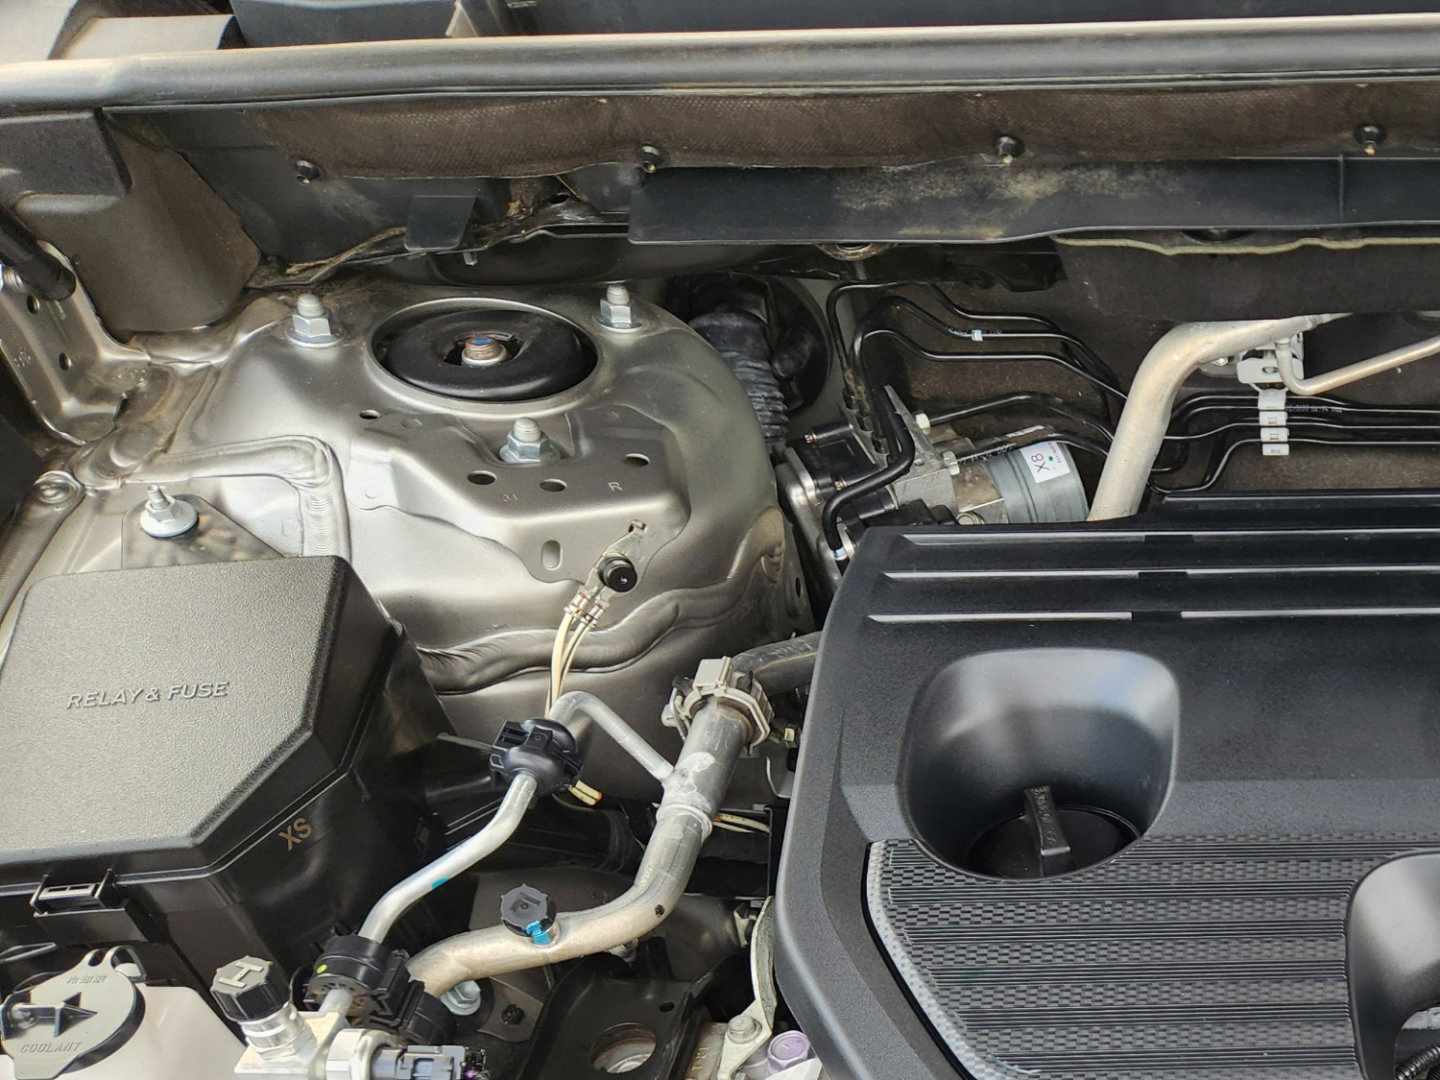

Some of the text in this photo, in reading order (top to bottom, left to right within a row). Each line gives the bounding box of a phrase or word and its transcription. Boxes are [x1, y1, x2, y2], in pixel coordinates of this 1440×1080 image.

[1030, 452, 1050, 474] X8
[66, 681, 230, 710] RELAY & FUSE
[278, 817, 312, 851] XS
[217, 961, 264, 988] H
[20, 1041, 83, 1053] COOLANT
